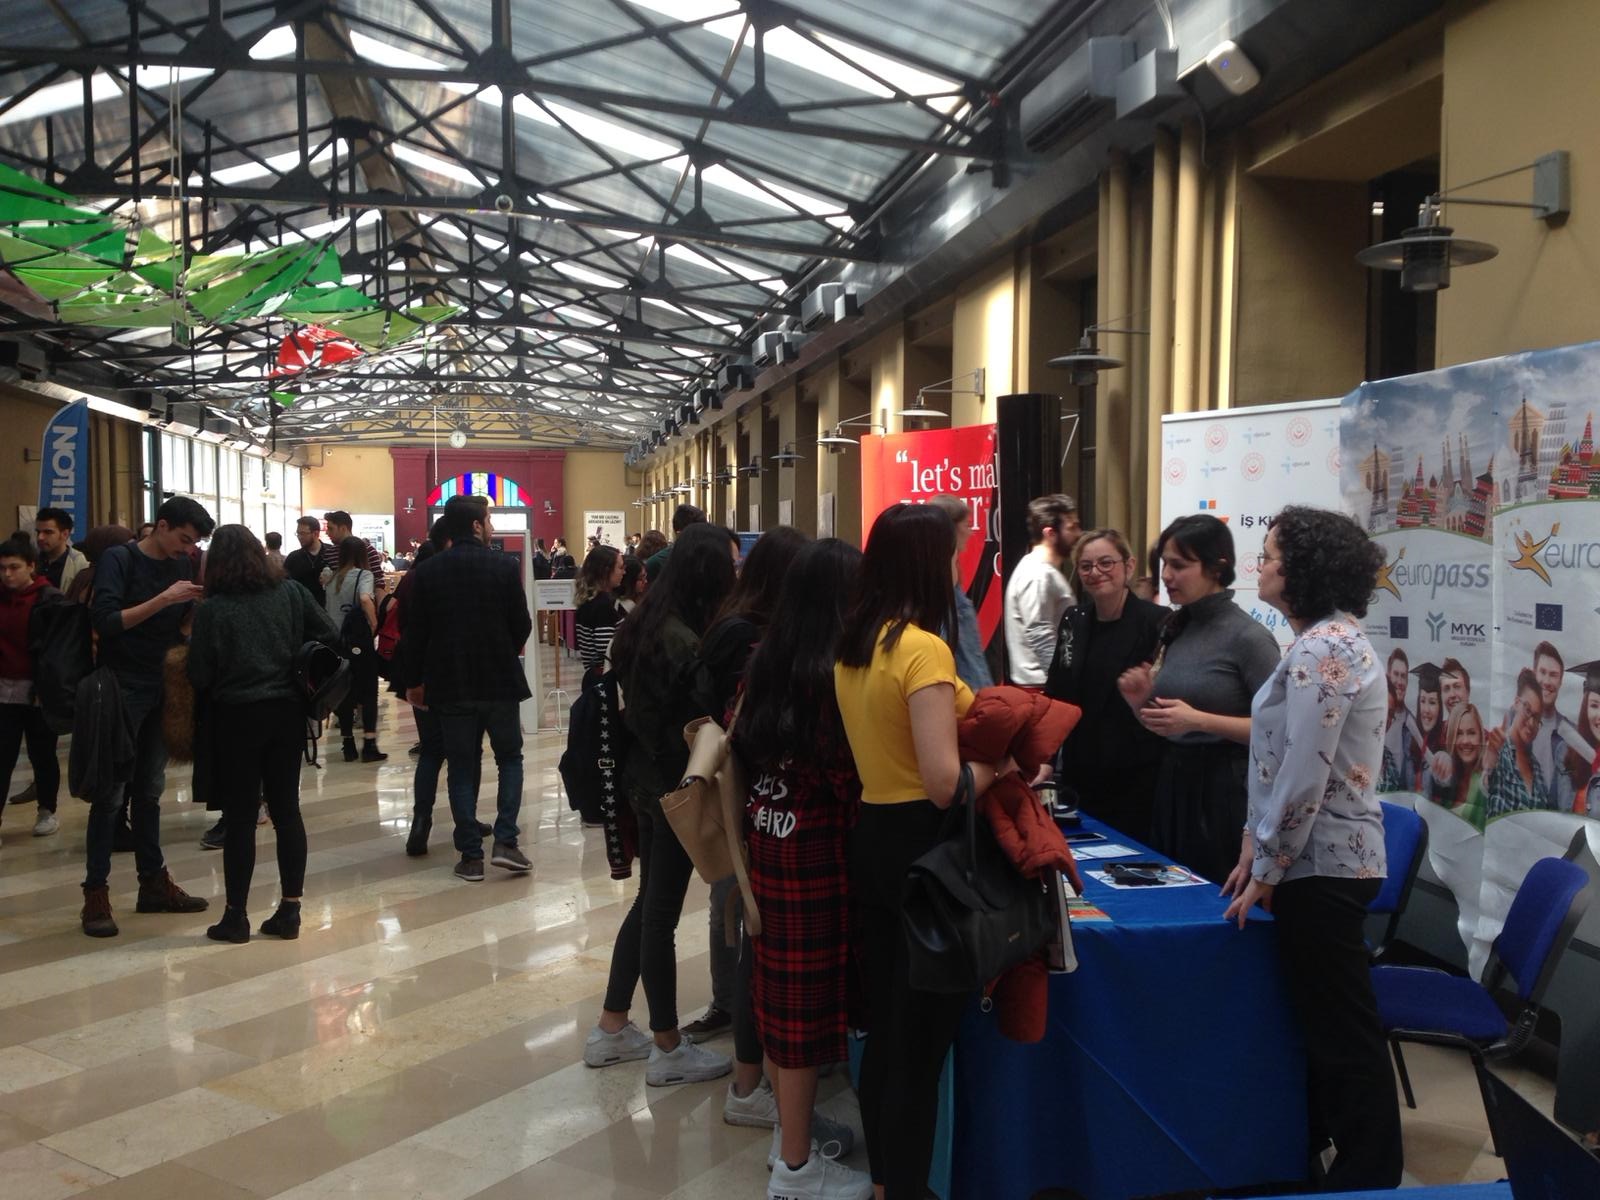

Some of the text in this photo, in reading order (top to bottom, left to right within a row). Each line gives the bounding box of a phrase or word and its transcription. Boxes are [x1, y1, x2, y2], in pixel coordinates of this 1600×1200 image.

[50, 426, 78, 515] HLON
[1395, 563, 1490, 600] europass
[1451, 622, 1486, 637] MYK
